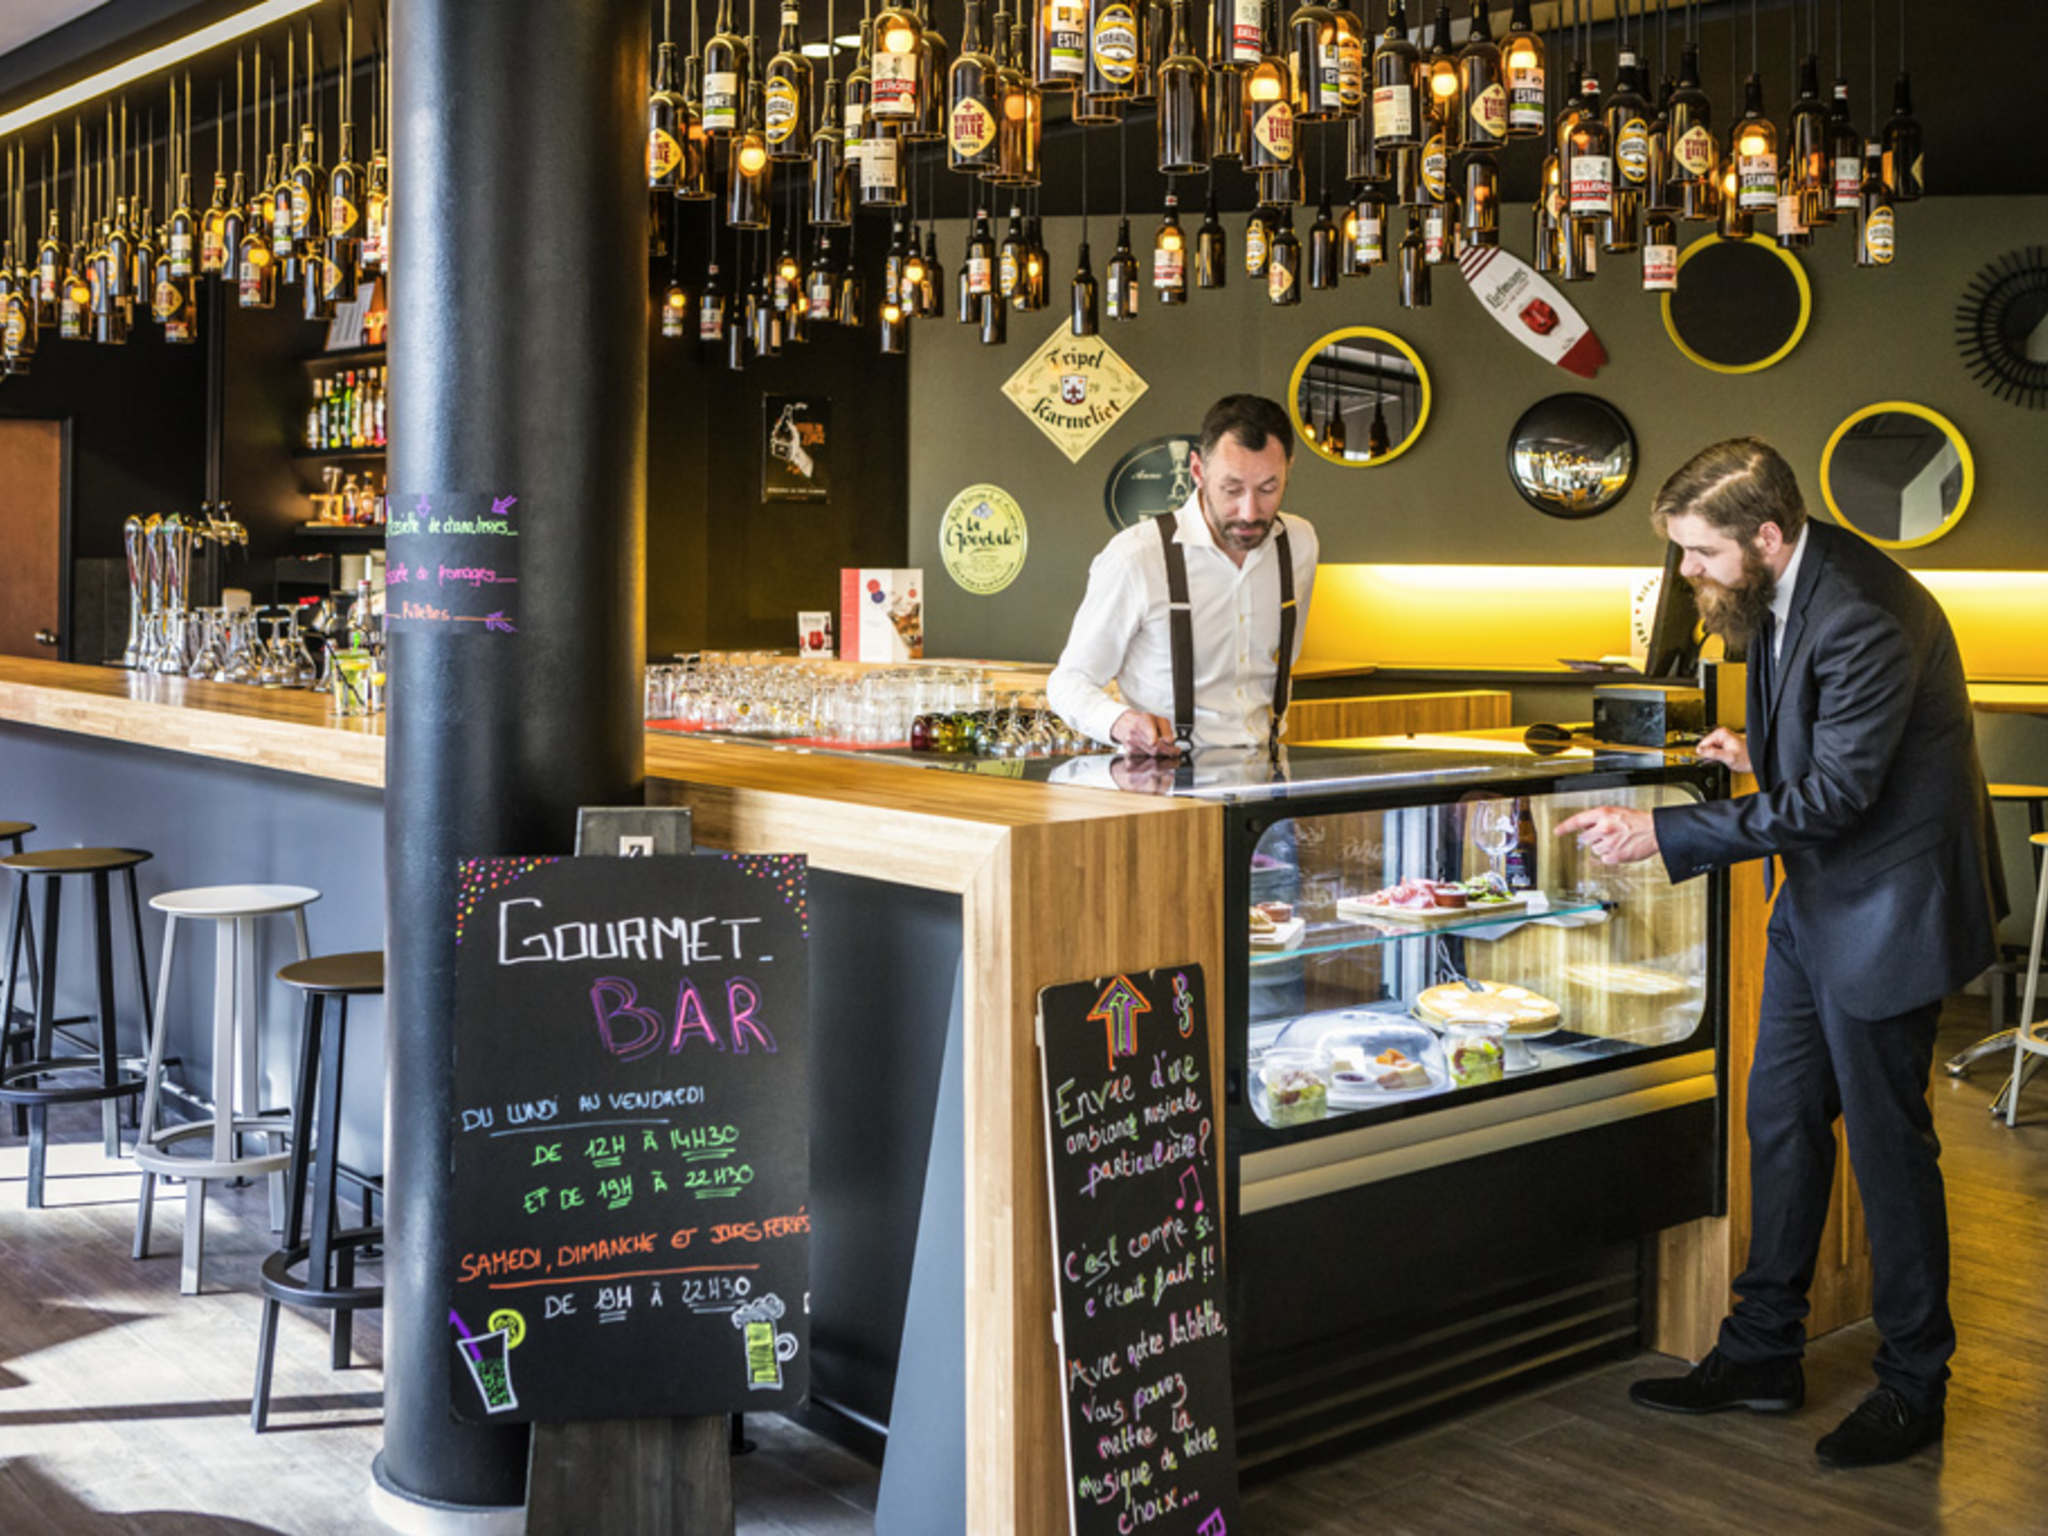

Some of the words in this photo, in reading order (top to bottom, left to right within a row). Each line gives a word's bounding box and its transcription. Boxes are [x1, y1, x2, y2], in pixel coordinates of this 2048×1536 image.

[1046, 348, 1105, 371] Tripel
[1031, 397, 1122, 429] Karmeliet
[590, 976, 778, 1063] BAR
[462, 1107, 494, 1132] DU
[579, 1092, 600, 1112] AU
[608, 1086, 705, 1111] VENDREDI
[1056, 1075, 1135, 1128] Envie
[531, 1144, 563, 1167] DE
[584, 1135, 627, 1160] 12H
[670, 1125, 740, 1150] 14H30
[523, 1187, 550, 1214] ET
[560, 1190, 586, 1210] DE
[684, 1164, 755, 1188] 22H30
[557, 1232, 659, 1268] DIMANCHE
[671, 1228, 699, 1249] ET
[545, 1293, 578, 1319] DE
[681, 1276, 752, 1304] 22H30
